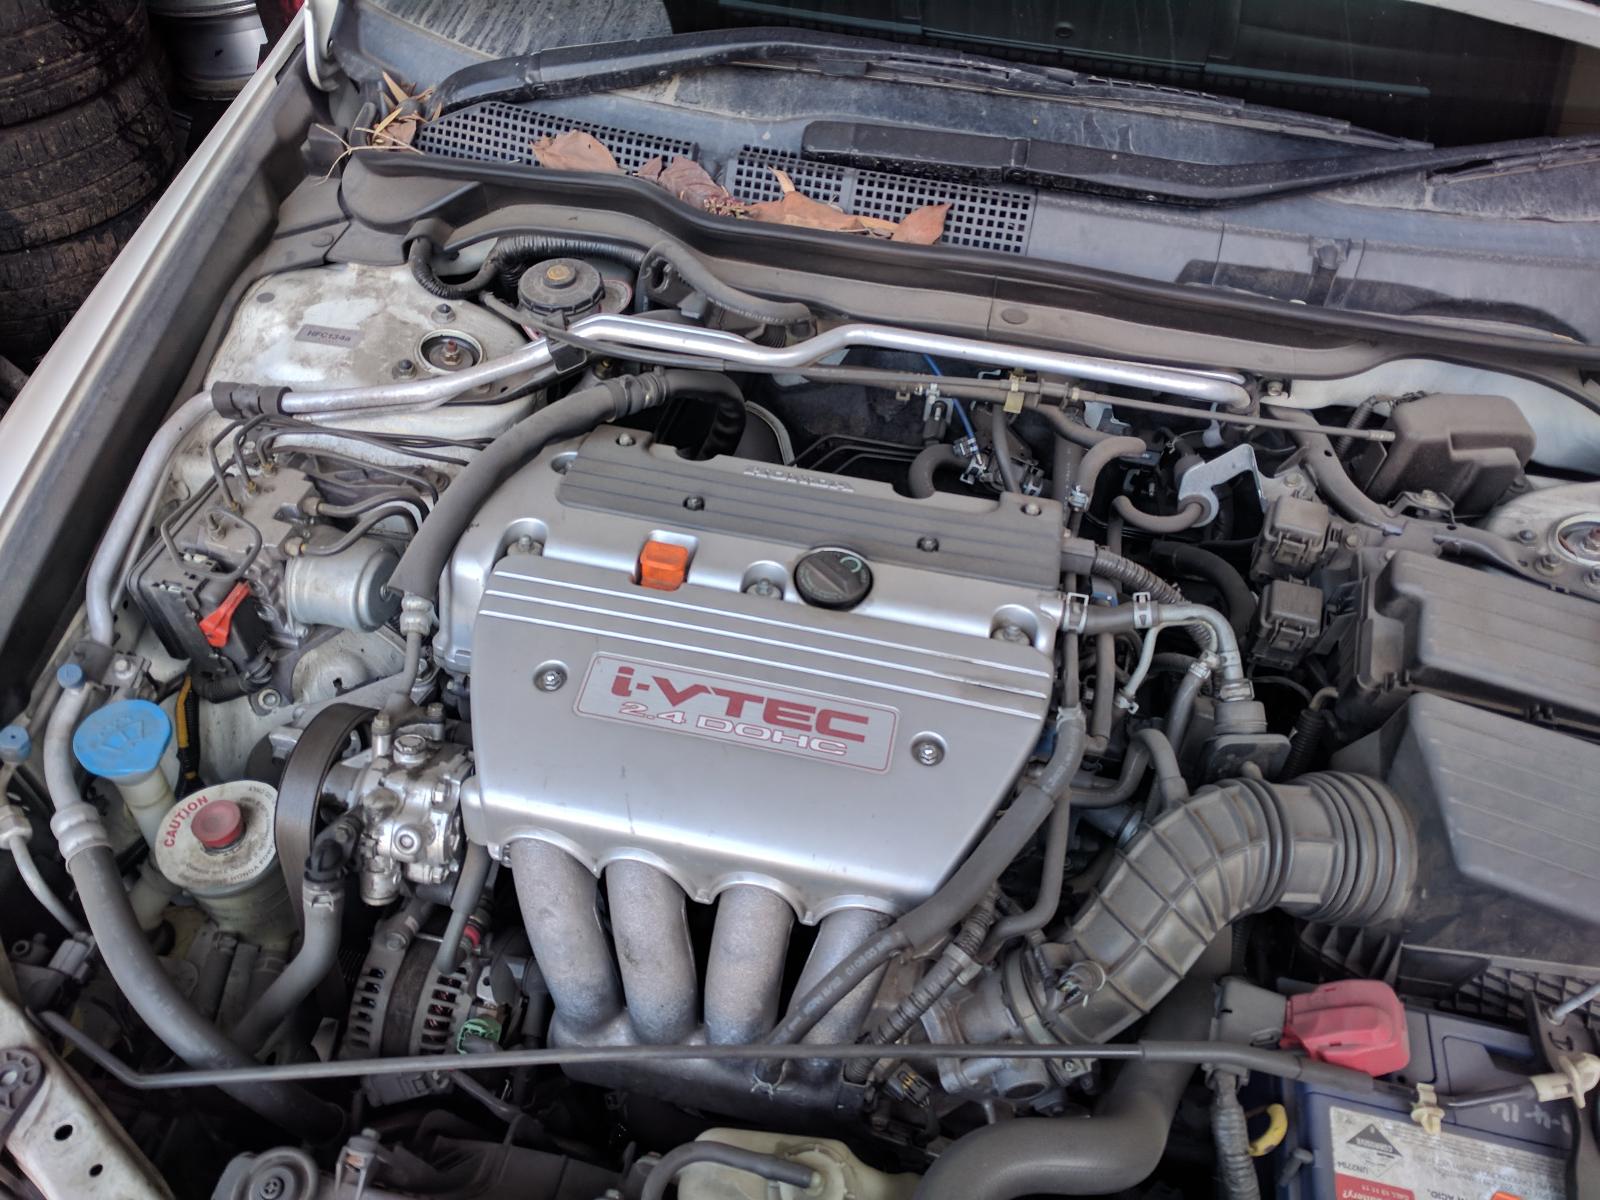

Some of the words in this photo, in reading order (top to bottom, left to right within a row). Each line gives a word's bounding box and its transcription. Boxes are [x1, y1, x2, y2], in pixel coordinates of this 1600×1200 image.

[611, 666, 870, 743] i-VTEC
[618, 700, 687, 728] 2.4
[696, 714, 848, 757] DOHC
[164, 795, 209, 849] CAUTION
